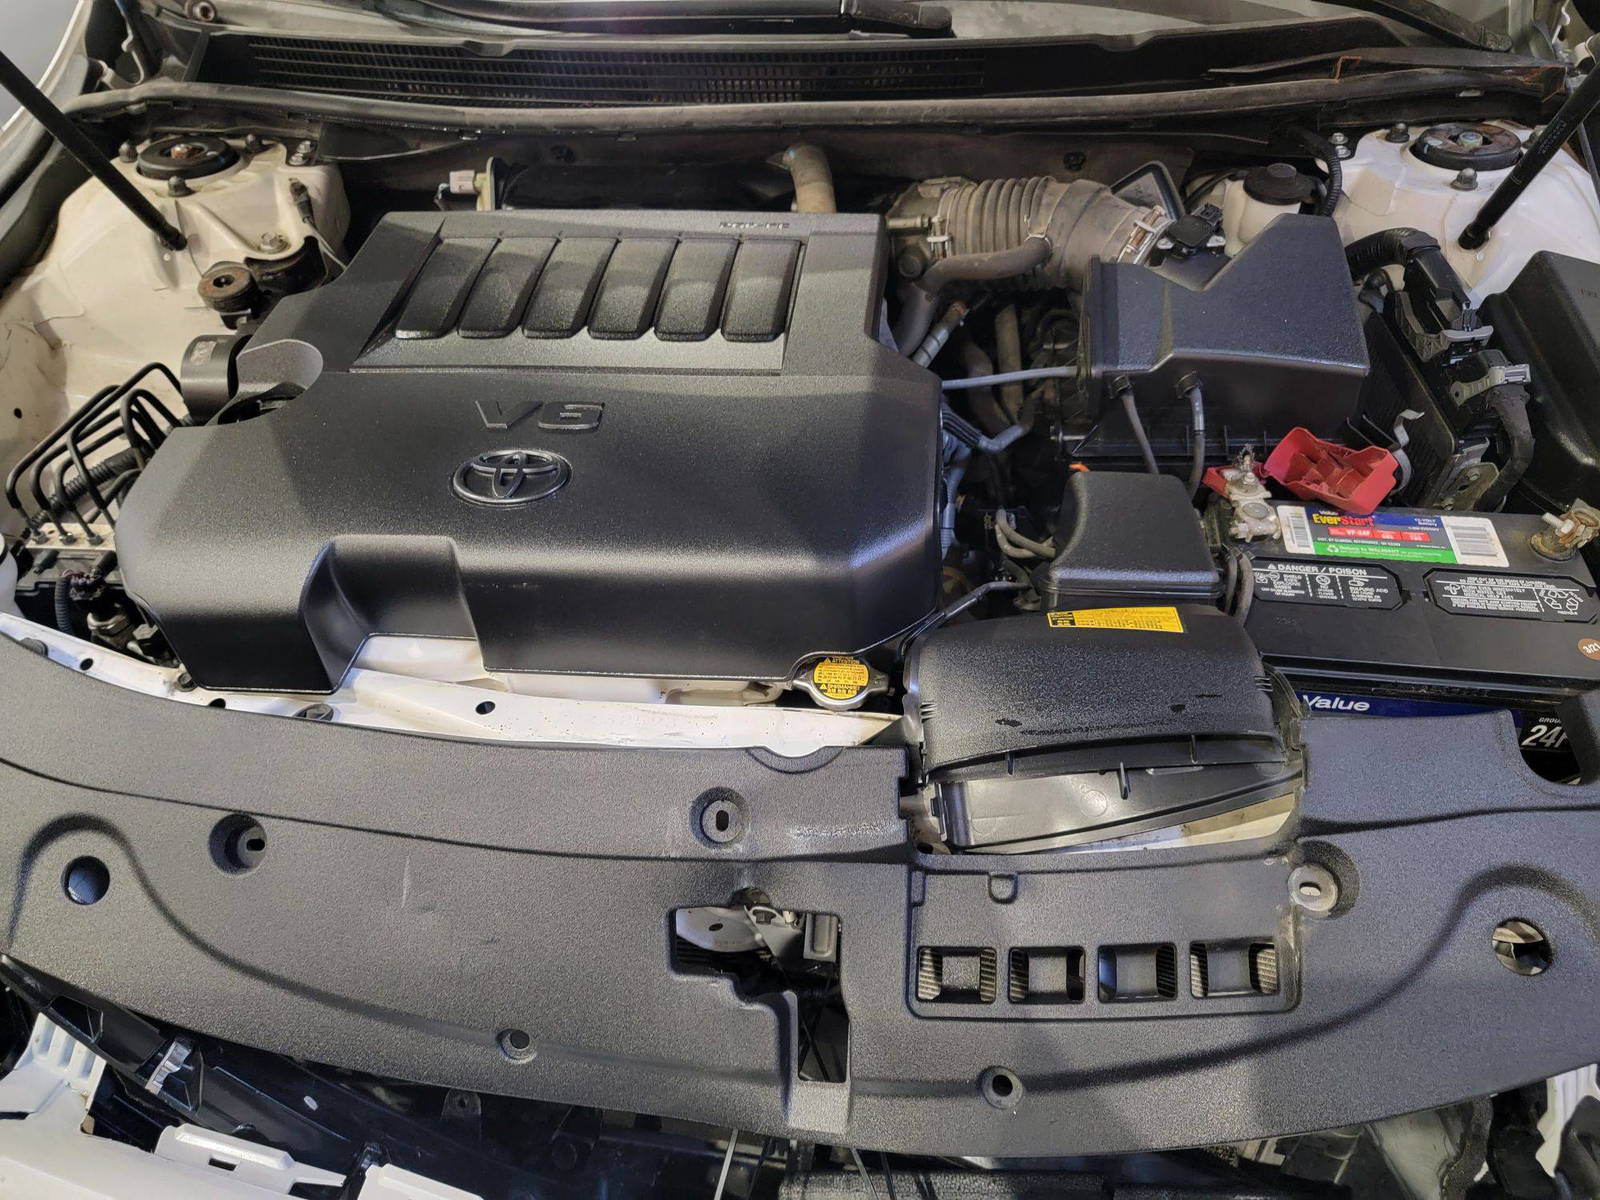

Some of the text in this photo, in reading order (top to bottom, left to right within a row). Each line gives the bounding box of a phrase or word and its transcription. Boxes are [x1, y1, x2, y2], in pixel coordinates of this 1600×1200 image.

[474, 399, 606, 432] V6
[1312, 513, 1374, 527] EverStart
[1277, 564, 1319, 573] DANGER
[1328, 567, 1368, 576] POISON
[1302, 694, 1371, 712] Value
[1538, 716, 1562, 724] GROU
